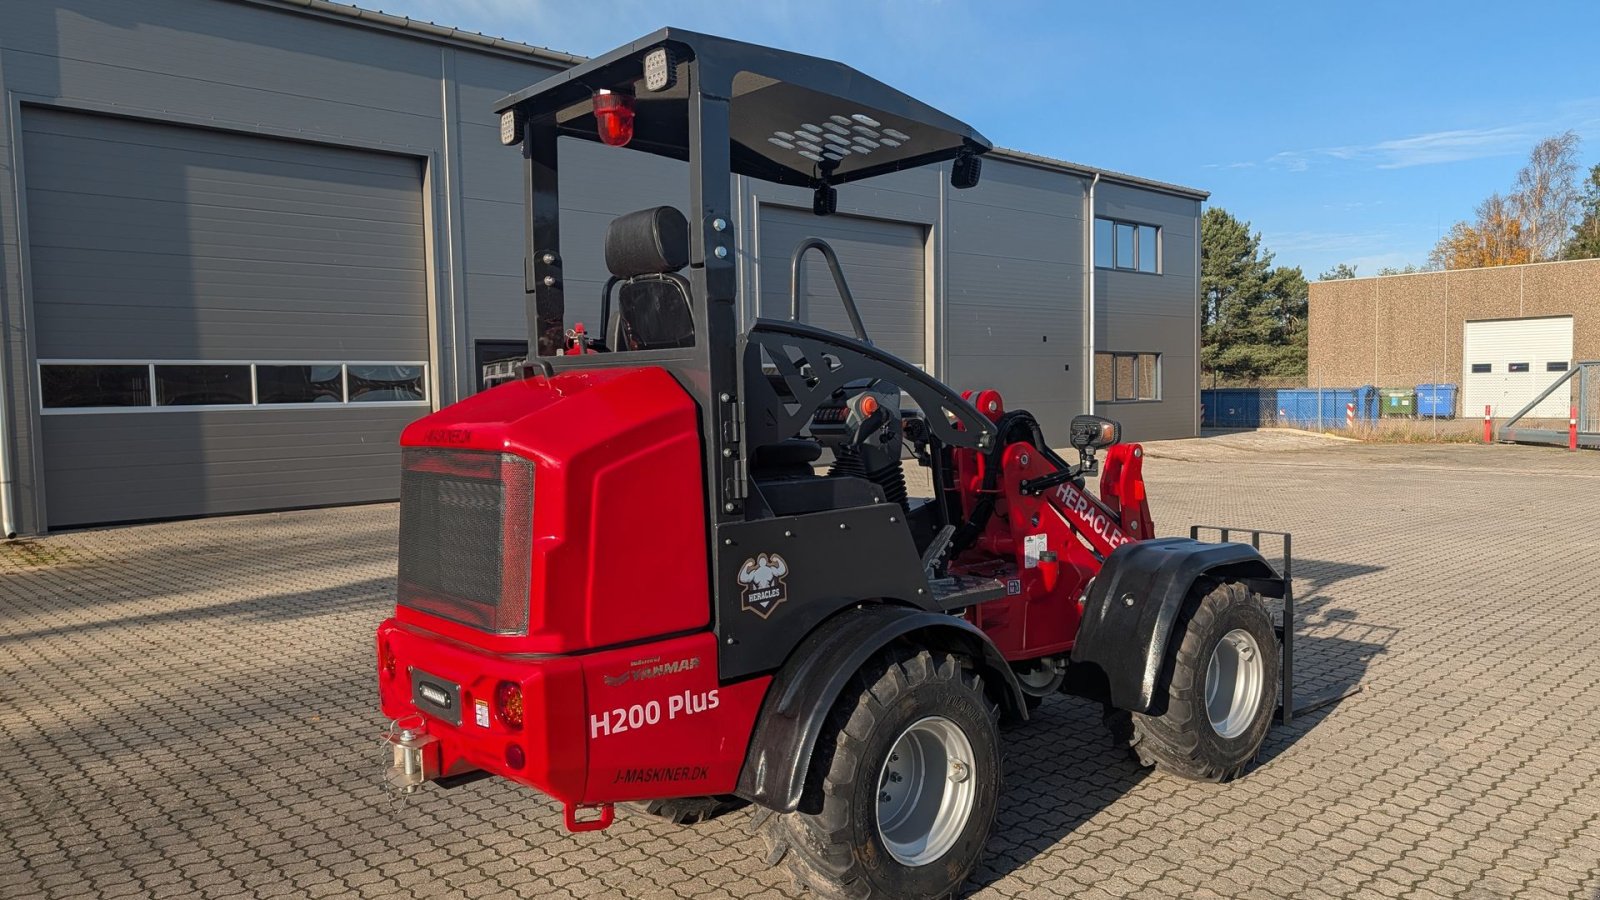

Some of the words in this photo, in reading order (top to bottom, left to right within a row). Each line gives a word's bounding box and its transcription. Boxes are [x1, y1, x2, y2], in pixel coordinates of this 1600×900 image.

[748, 588, 780, 602] HERACLES
[591, 700, 661, 739] H200
[668, 689, 720, 720] Plus
[612, 765, 710, 785] J-MASKINER.DK
